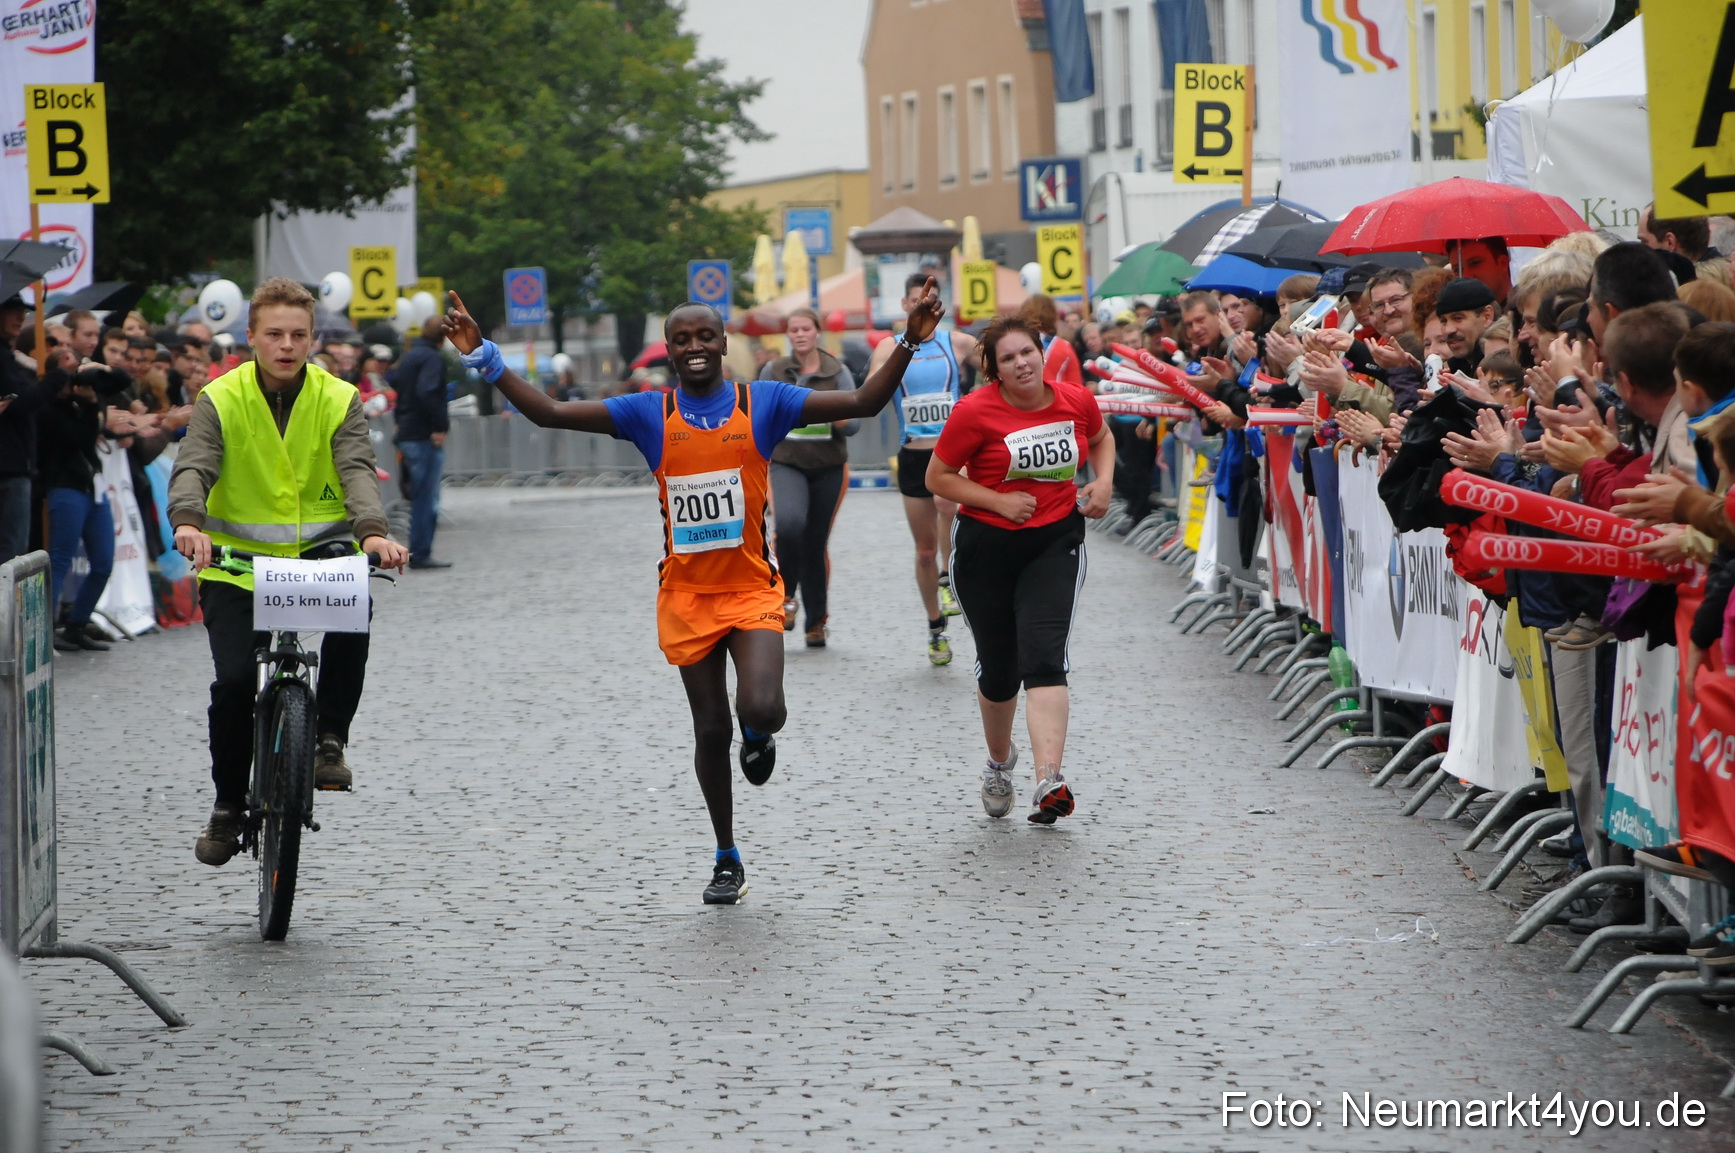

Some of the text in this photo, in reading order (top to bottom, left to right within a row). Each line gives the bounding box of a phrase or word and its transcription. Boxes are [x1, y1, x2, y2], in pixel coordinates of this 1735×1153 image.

[1185, 69, 1245, 90] Block
[33, 88, 95, 109] Block
[1195, 101, 1233, 157] B
[47, 120, 88, 176] B
[1041, 229, 1078, 241] Block
[354, 248, 390, 260] Block
[1052, 246, 1073, 280] C
[362, 266, 384, 300] C
[970, 279, 988, 305] D
[908, 404, 950, 423] 2000
[730, 433, 748, 441] asics
[1007, 429, 1062, 446] PARTL Neumarkt
[1018, 438, 1072, 470] 5058
[687, 479, 727, 491] Neumarkt
[674, 489, 735, 523] 2001
[1543, 506, 1602, 537] BKK
[687, 526, 728, 542] Zachary
[1566, 545, 1619, 567] BKK
[265, 570, 355, 582] Erster Mann
[264, 595, 357, 608] 10,5 km Lauf
